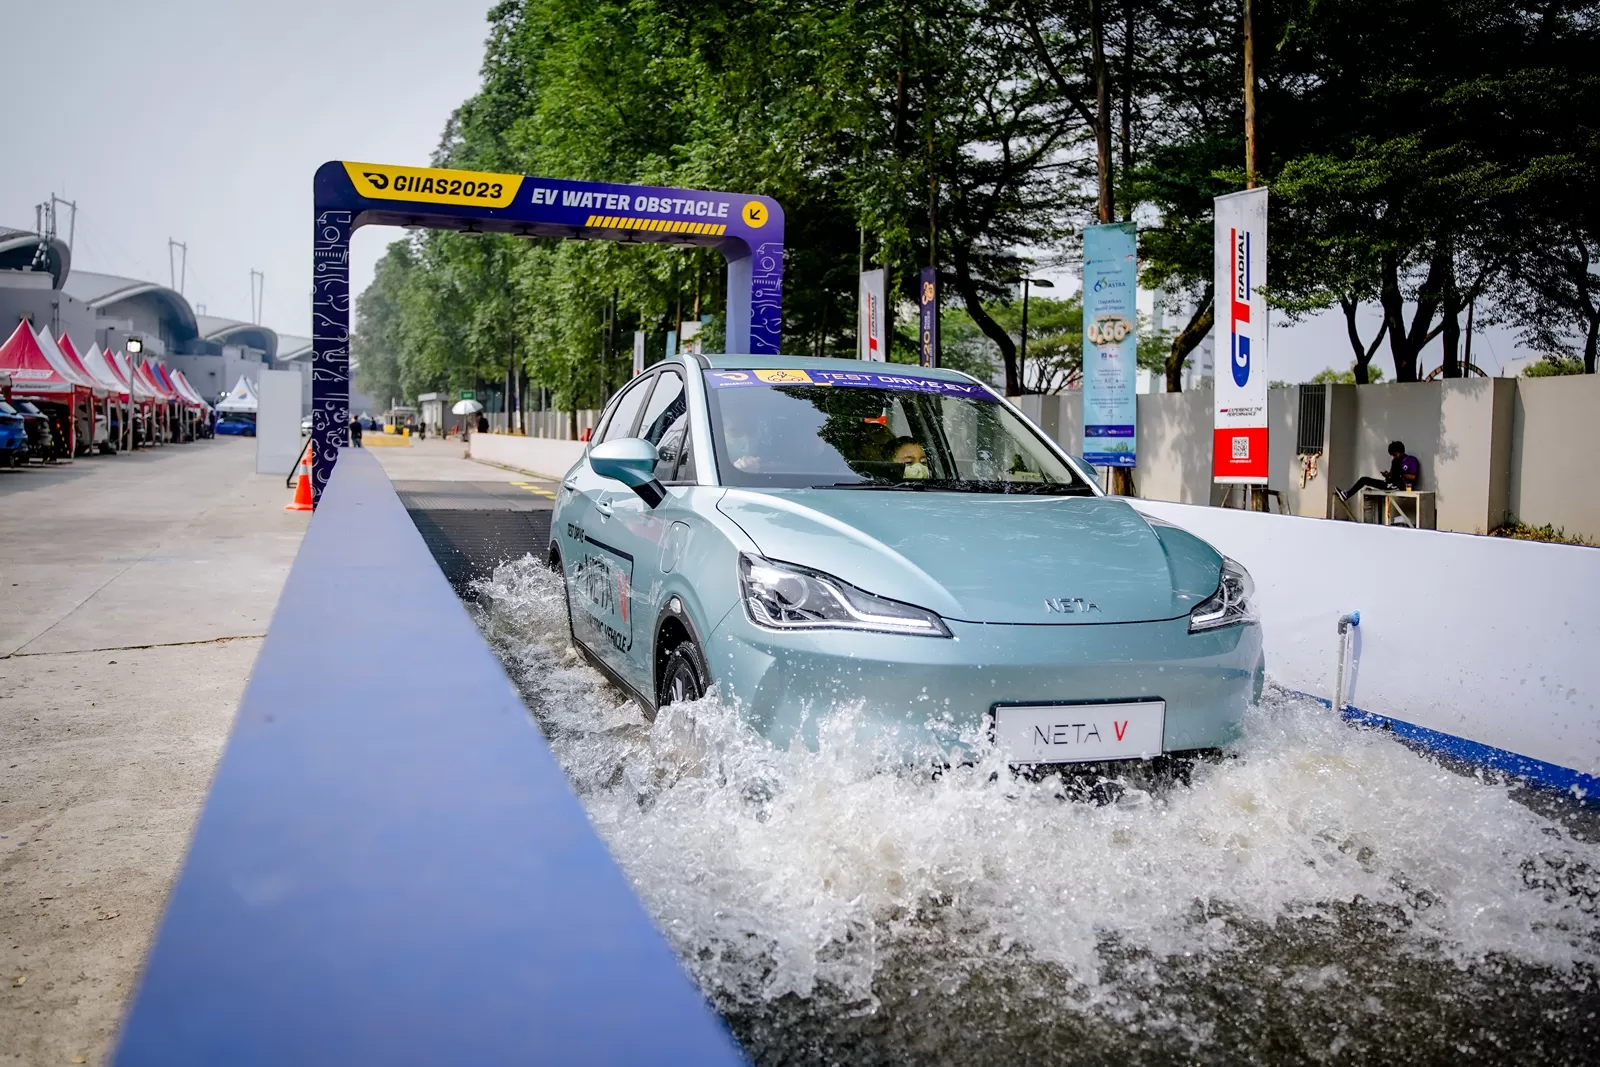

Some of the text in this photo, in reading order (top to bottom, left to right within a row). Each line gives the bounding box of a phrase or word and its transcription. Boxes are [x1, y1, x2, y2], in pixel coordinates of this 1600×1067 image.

[393, 175, 503, 199] GIIAS2023
[531, 187, 730, 218] EV WATER OBSTACLE
[1231, 298, 1250, 388] GT
[817, 372, 872, 382] TEST
[878, 374, 940, 388] DRIVE
[943, 383, 973, 393] EV
[1043, 598, 1102, 614] NETA
[1033, 720, 1129, 746] NETA V
